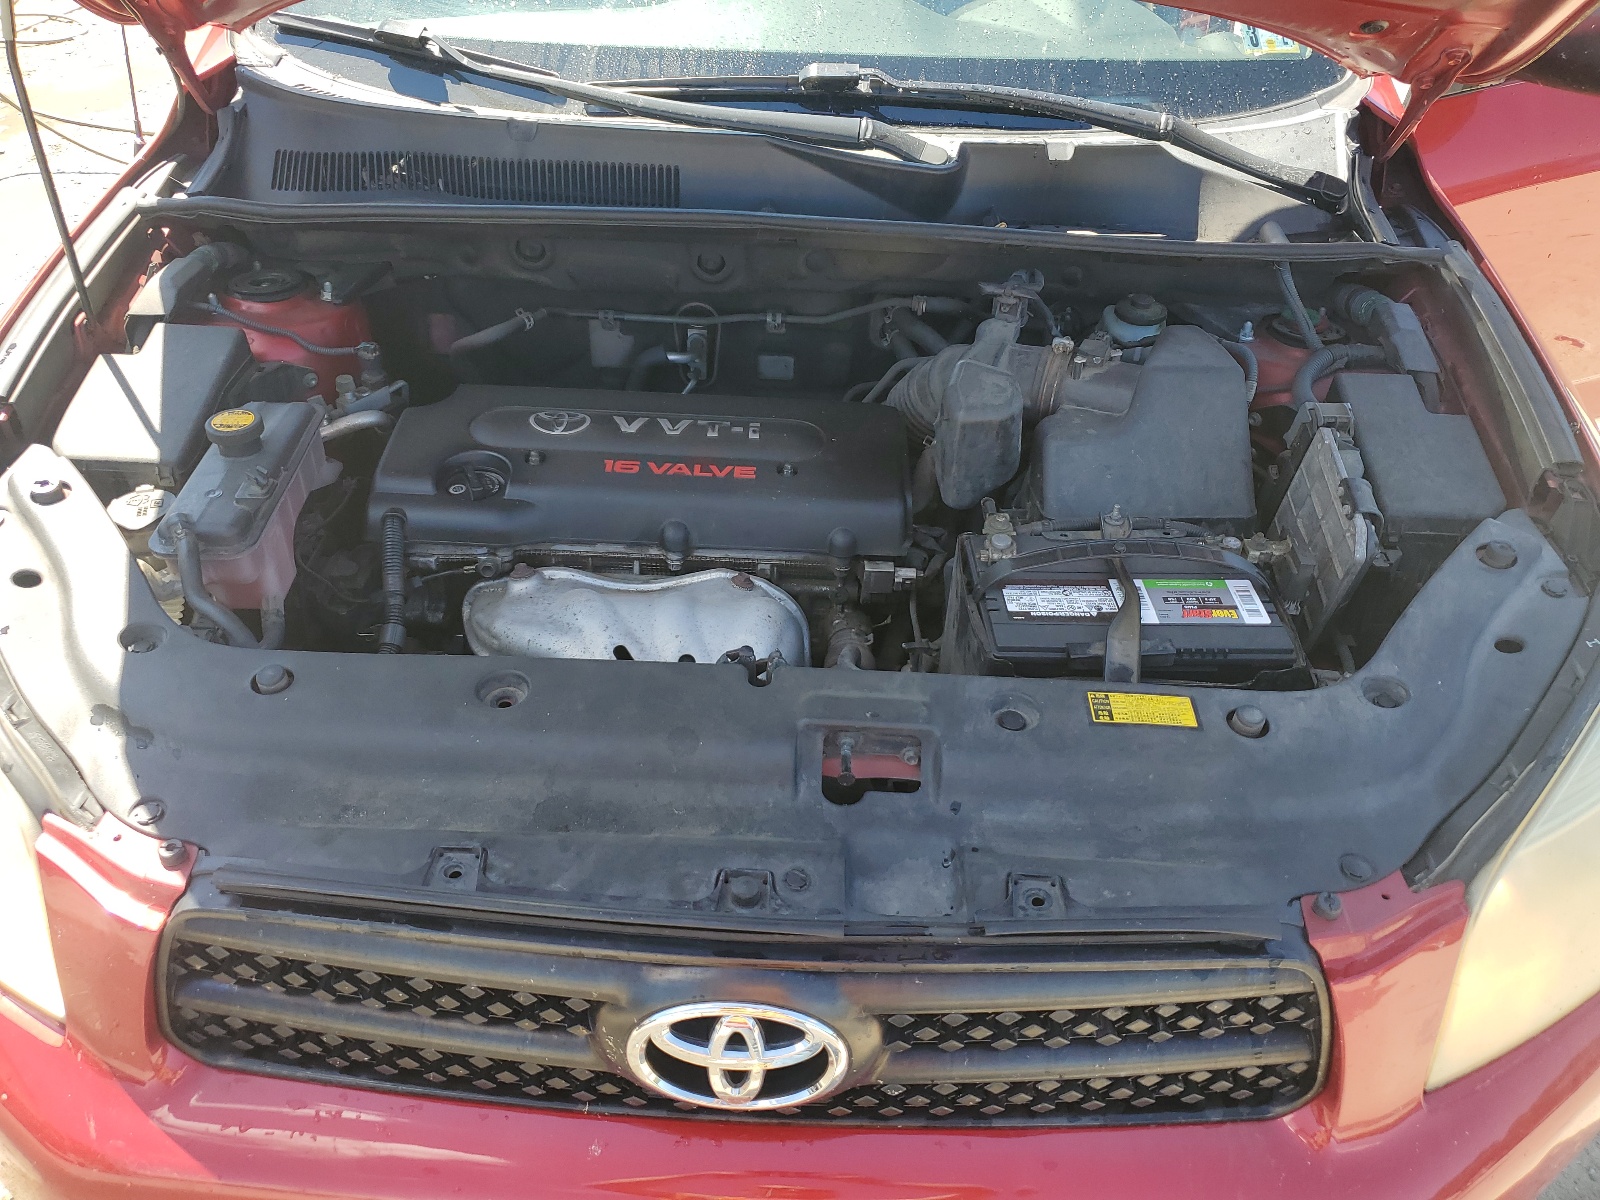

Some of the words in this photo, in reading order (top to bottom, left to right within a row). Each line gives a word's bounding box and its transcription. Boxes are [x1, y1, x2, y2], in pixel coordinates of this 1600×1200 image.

[604, 459, 641, 474] 16
[647, 461, 757, 479] VALVE
[1182, 608, 1239, 619] EverStart
